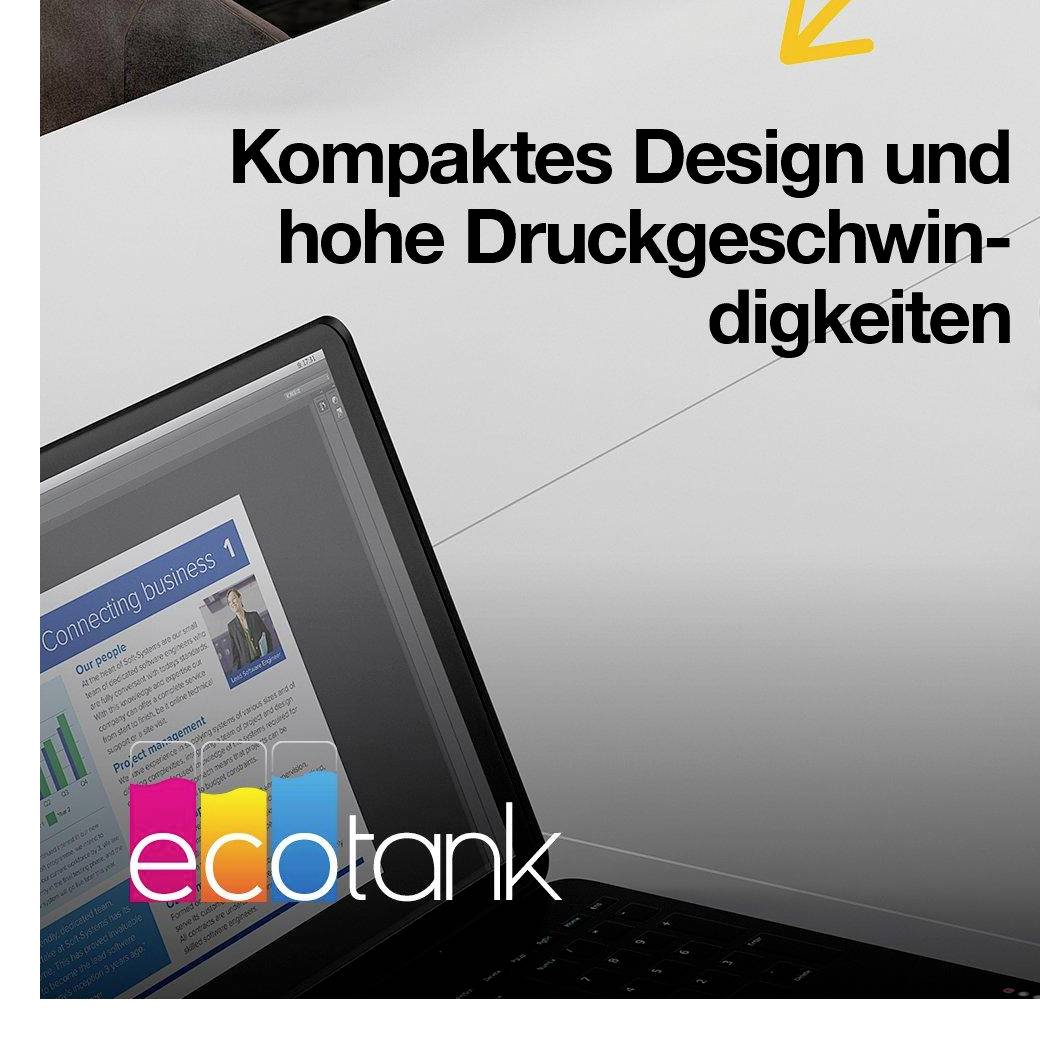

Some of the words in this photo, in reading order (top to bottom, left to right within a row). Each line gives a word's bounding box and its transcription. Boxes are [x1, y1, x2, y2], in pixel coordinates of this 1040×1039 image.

[40, 590, 142, 653] Connecting
[140, 550, 217, 603] business
[221, 537, 235, 560] 1
[74, 658, 94, 675] Our
[94, 641, 128, 667] people
[112, 747, 148, 775] Project
[147, 715, 207, 756] management
